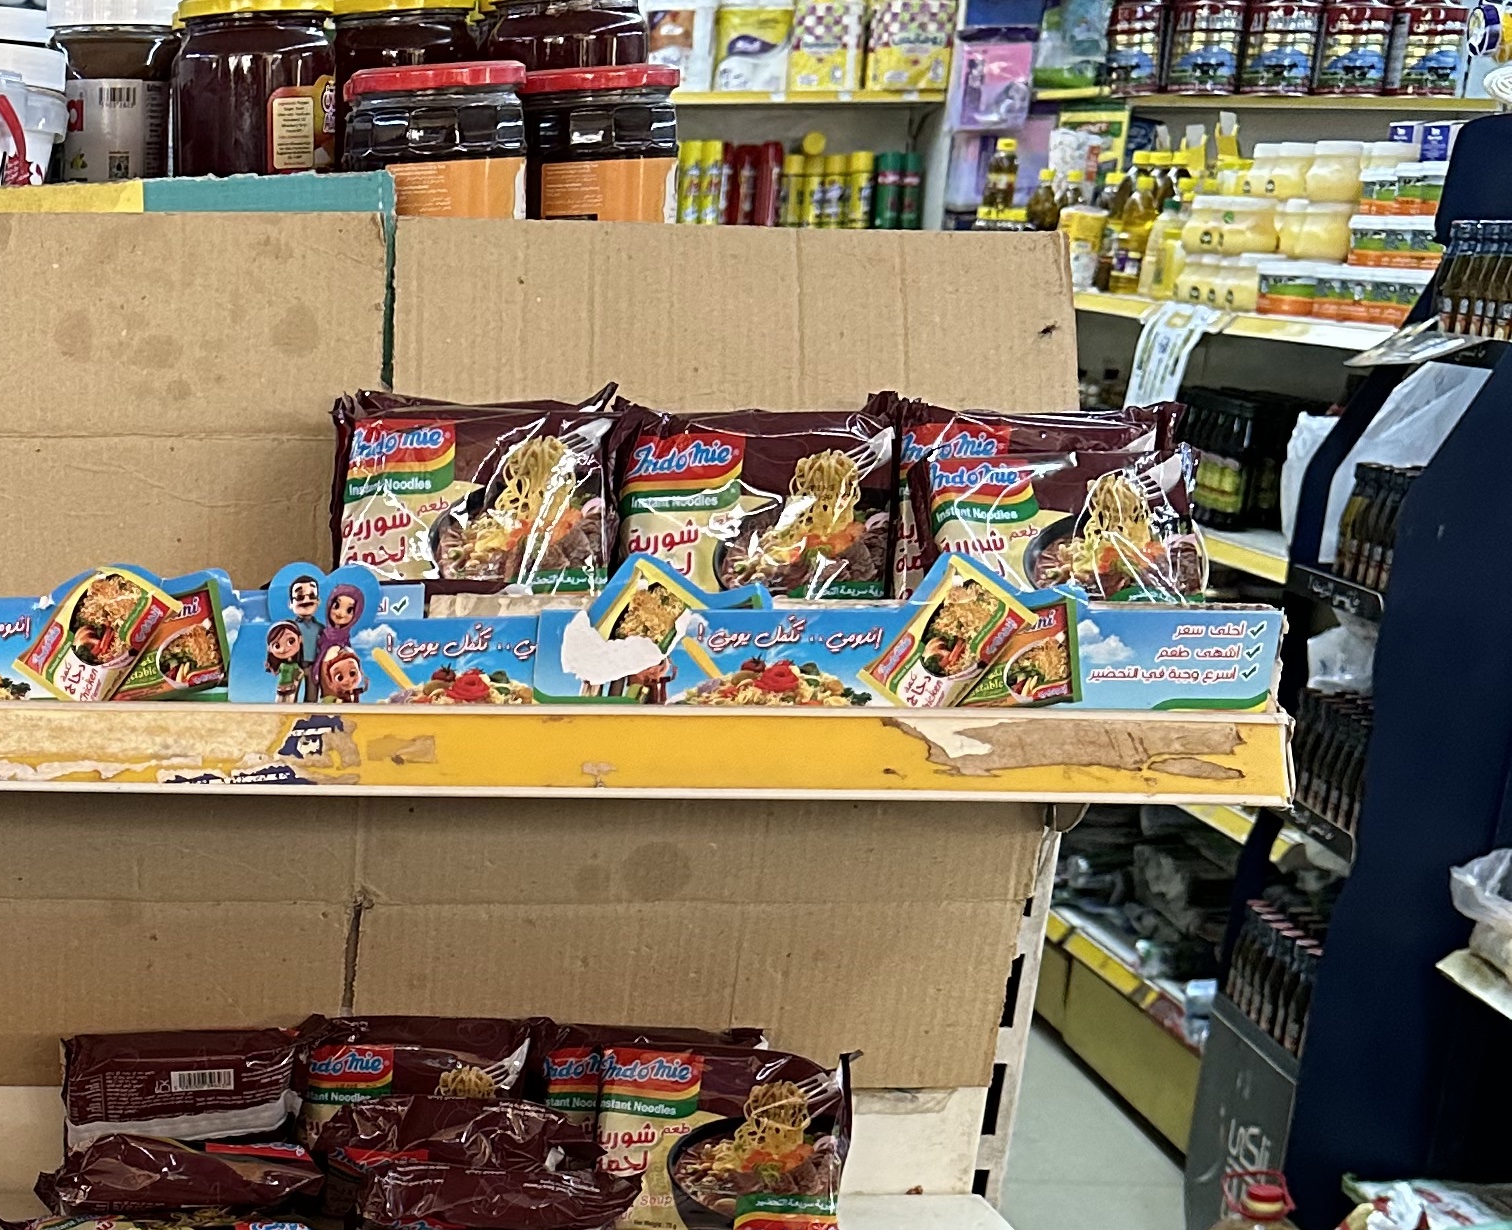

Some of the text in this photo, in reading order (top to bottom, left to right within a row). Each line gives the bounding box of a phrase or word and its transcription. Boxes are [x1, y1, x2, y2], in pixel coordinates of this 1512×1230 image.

[626, 440, 732, 475] Indomie
[384, 477, 432, 493] Noodles
[416, 497, 450, 516] طعم
[936, 507, 971, 521] Instant
[1174, 624, 1204, 638] سعر
[1156, 647, 1191, 660] طعم
[1089, 667, 1139, 681] التحضير
[1141, 668, 1165, 683] في
[1168, 669, 1200, 683] وجبة
[309, 1049, 385, 1076] ndomie
[602, 1053, 692, 1082] Indomie
[601, 1099, 631, 1112] nstant
[633, 1101, 677, 1116] Noodles
[660, 1121, 691, 1136] طعم
[640, 1193, 673, 1207] Soup
